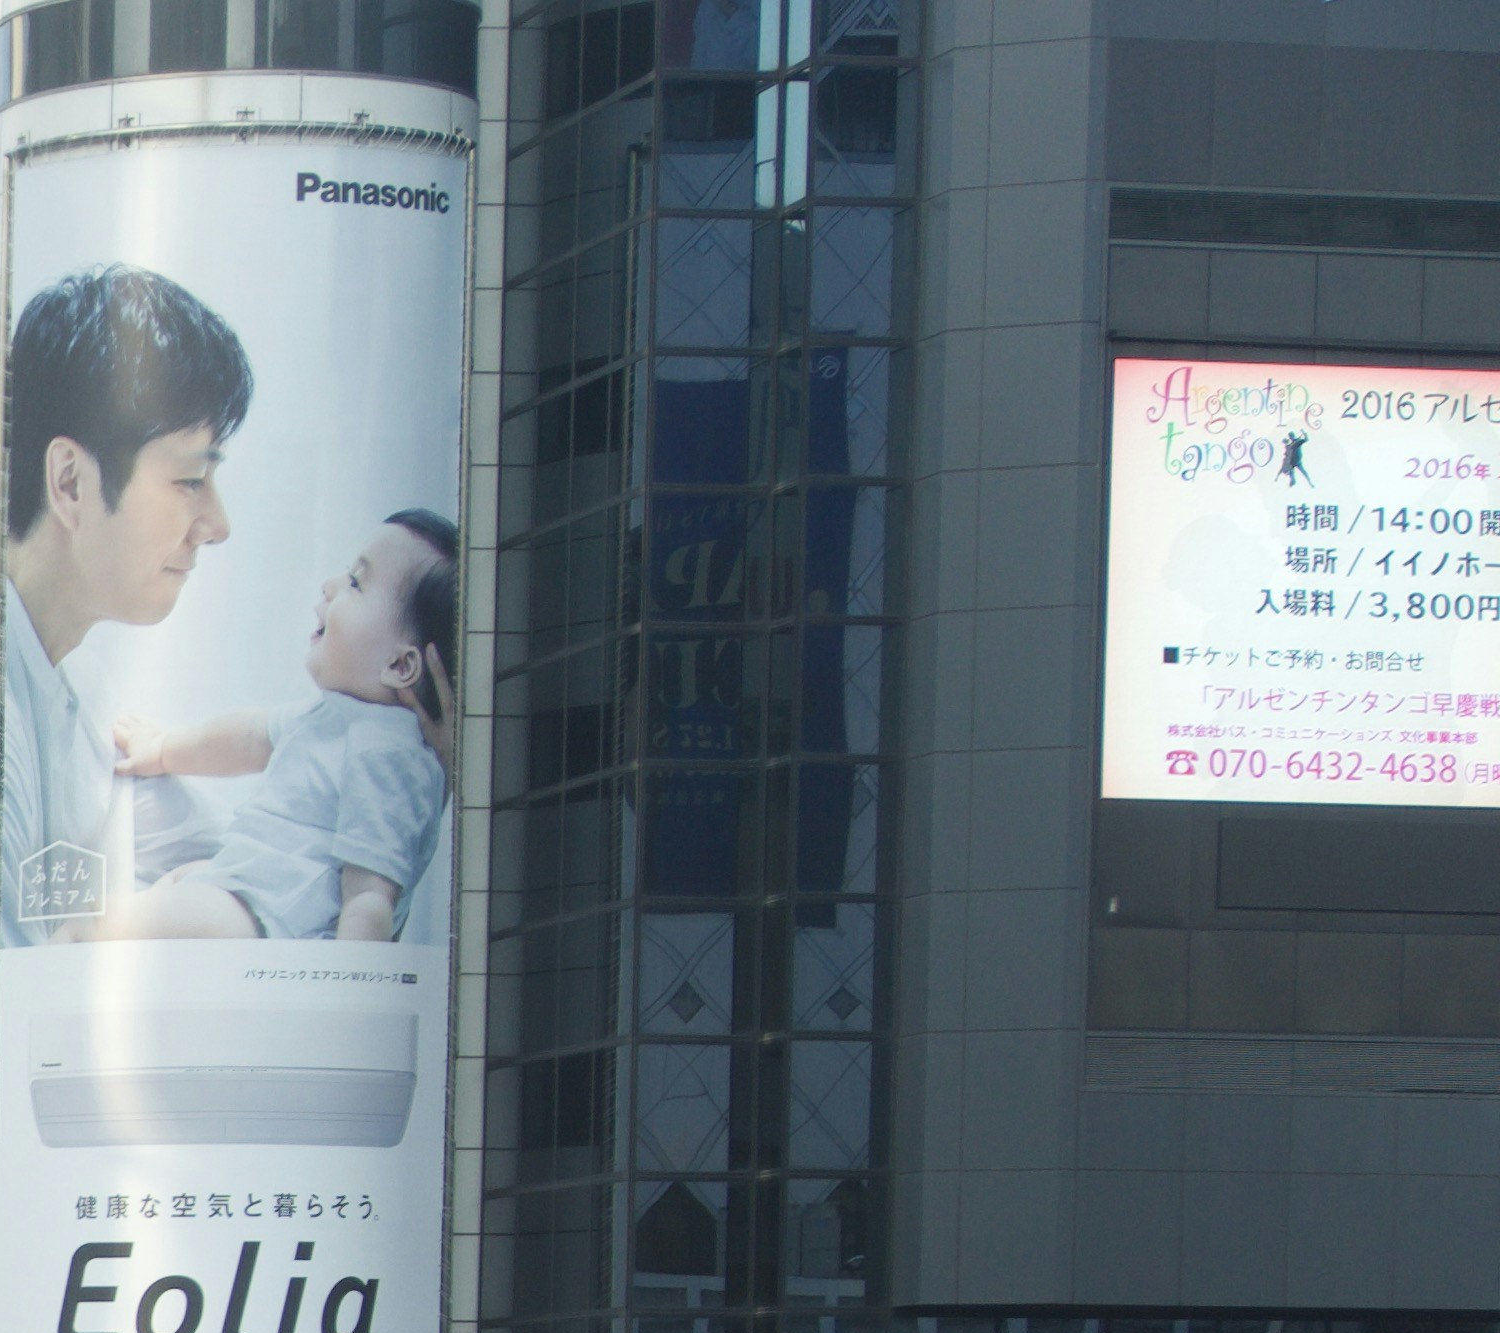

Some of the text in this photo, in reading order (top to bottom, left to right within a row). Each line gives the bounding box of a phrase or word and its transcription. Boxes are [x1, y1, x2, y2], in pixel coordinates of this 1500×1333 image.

[296, 172, 450, 215] Panasonic
[1145, 366, 1324, 434] Argentine
[1341, 390, 1416, 421] 2016
[1160, 422, 1275, 484] tango
[1209, 748, 1458, 785] 070-6432-4638
[32, 859, 91, 885] ふだん
[26, 887, 97, 909] プレミアム
[245, 968, 307, 981] パナソニック
[75, 1192, 381, 1223] 健康な空気と暮らそう。
